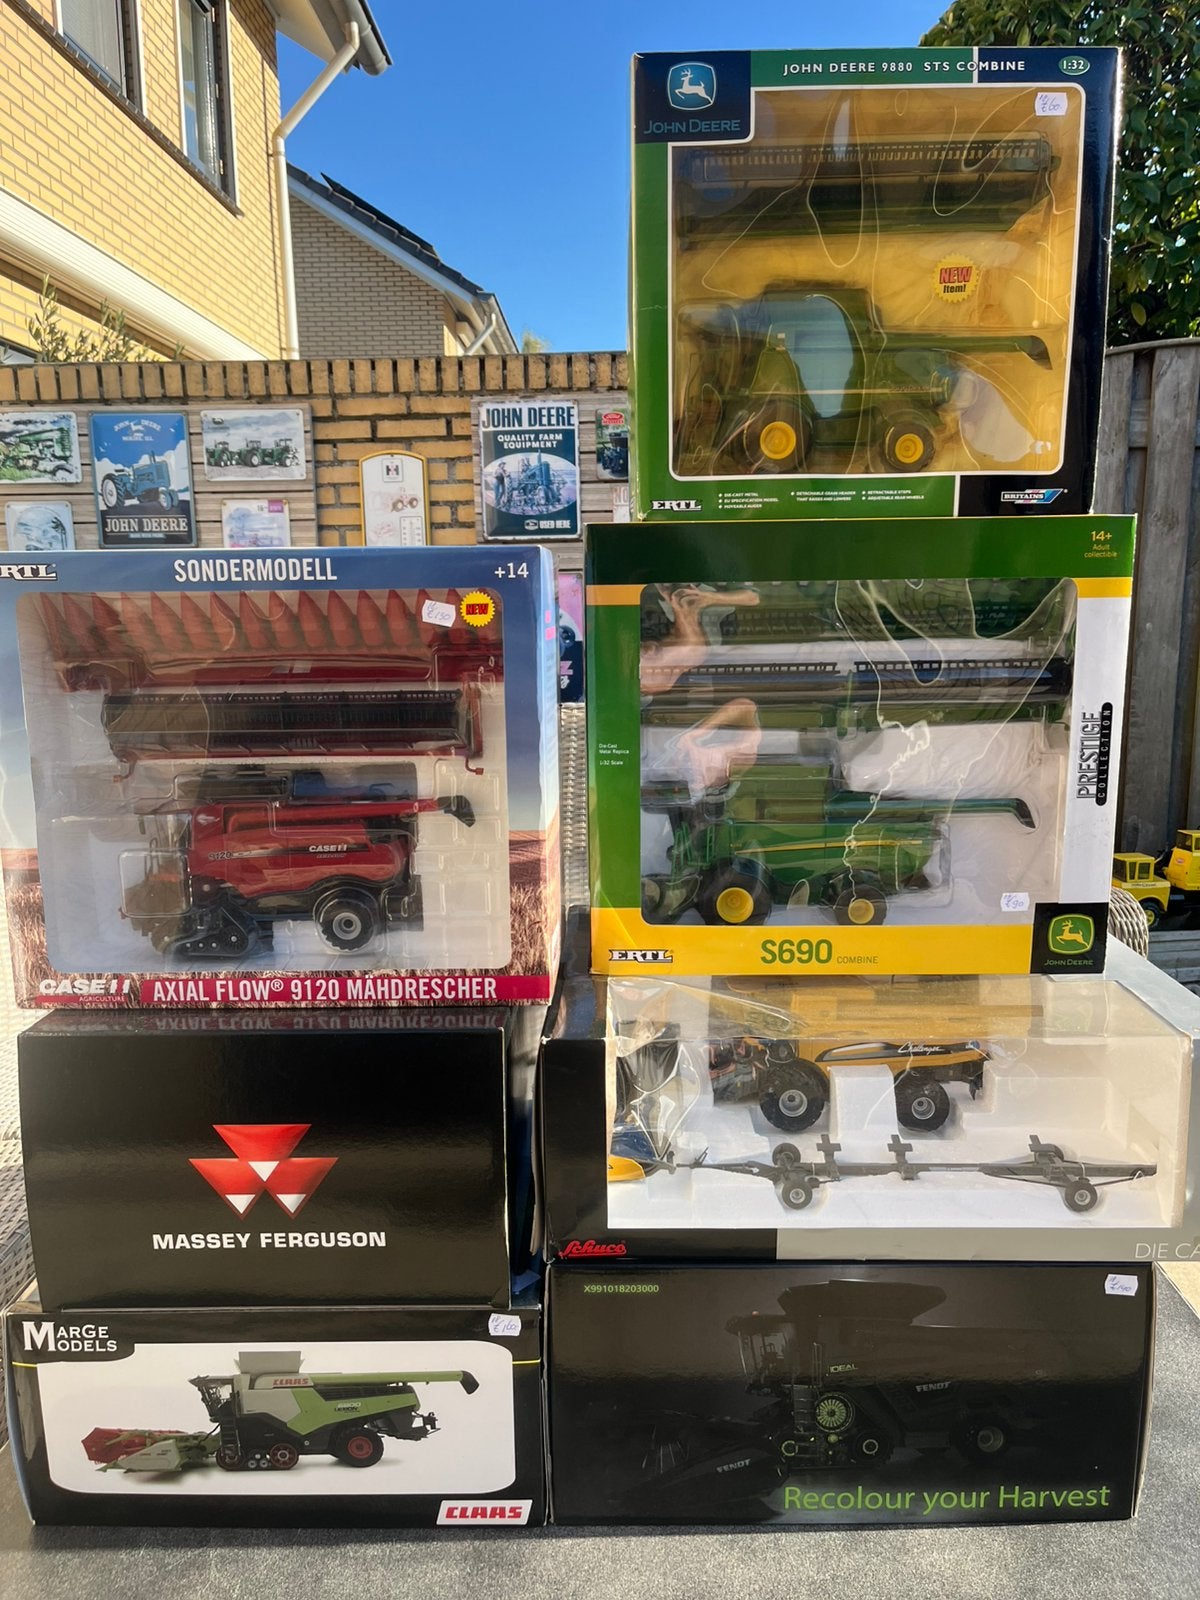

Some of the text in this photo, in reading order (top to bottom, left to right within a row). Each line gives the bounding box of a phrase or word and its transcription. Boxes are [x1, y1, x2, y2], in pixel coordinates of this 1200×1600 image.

[783, 61, 1025, 76] JOHN DEERE 9880 STS COMBINE
[1063, 59, 1085, 70] 1:32
[643, 118, 741, 134] JOHN DEERE
[939, 265, 973, 284] NEW
[943, 284, 967, 294] Item!
[482, 406, 575, 429] JOHN DEERE
[497, 433, 563, 442] QUALITY FARM
[503, 440, 558, 449] EQUIPMENT
[1003, 492, 1045, 500] BRITAINS
[652, 500, 702, 511] ERTL
[105, 517, 189, 533] JOHN DEERE
[1091, 530, 1113, 542] 14+
[1092, 543, 1110, 551] Adult
[0, 564, 57, 581] RTL
[174, 557, 338, 583] SONDERMODELL
[494, 562, 529, 579] +14
[466, 603, 489, 616] NEW
[1076, 710, 1102, 799] PRESTIGE
[1097, 710, 1111, 798] COLLECTION
[309, 845, 337, 853] CASE
[609, 949, 673, 963] ERTL
[760, 938, 833, 965] S690
[836, 955, 879, 965] COMBINE
[1066, 958, 1094, 966] DEERE
[39, 978, 110, 994] CASE
[153, 980, 210, 1002] AXIAL
[290, 979, 340, 1000] 9120
[346, 975, 497, 1000] MÄHDRESCHER
[898, 1041, 946, 1056] Challenger
[152, 1231, 387, 1250] MASSEY FERGUSON
[558, 1239, 627, 1257] Schuco
[1135, 1242, 1169, 1259] DIE
[583, 1284, 660, 1293] X991018203000
[829, 1363, 859, 1373] IDEAL
[272, 1378, 309, 1386] CLAAS
[915, 1381, 952, 1393] FENDT
[716, 1458, 751, 1473] FENDT
[784, 1485, 1111, 1515] Recolour your Harvest
[445, 1506, 523, 1519] CLAAS
